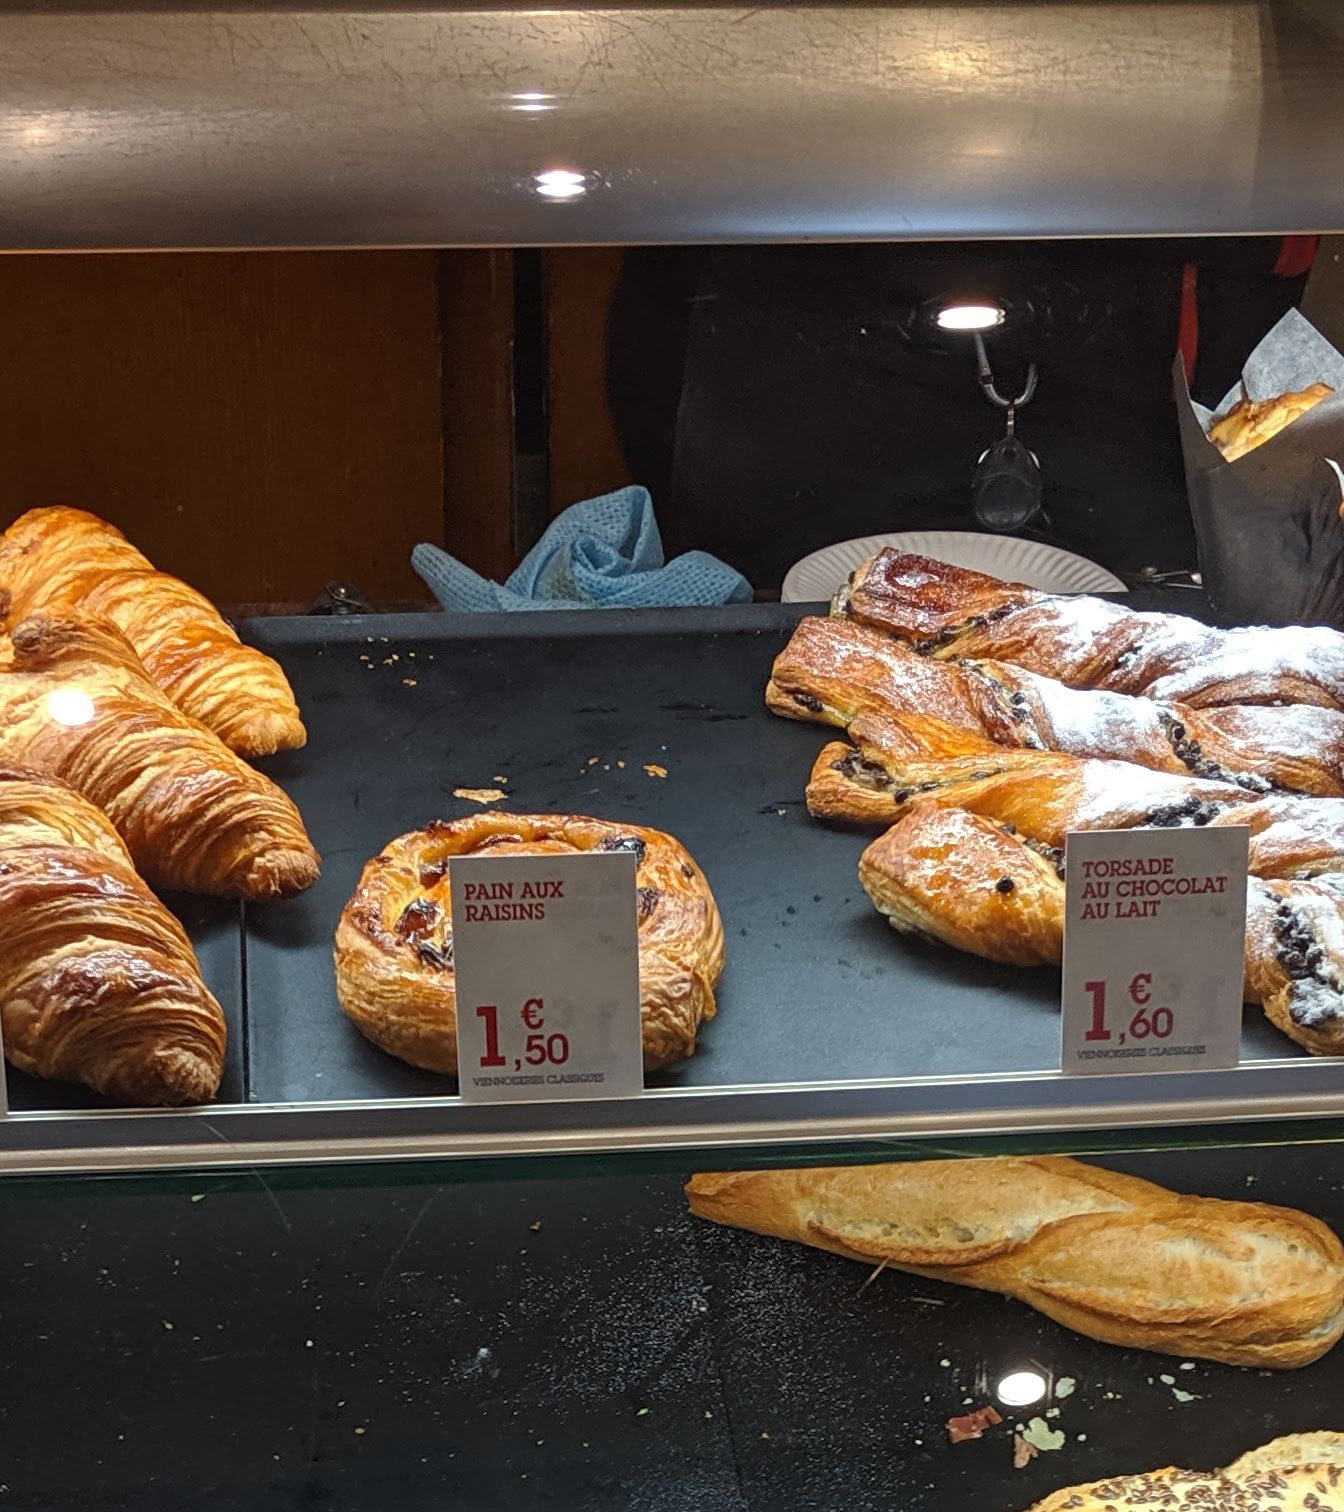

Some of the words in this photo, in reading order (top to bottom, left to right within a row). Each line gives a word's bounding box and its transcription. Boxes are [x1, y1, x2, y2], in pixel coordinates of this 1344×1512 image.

[1082, 858, 1174, 878] TORSADE
[464, 882, 513, 901] PAIN
[520, 881, 565, 899] AUX
[1081, 881, 1110, 899] AU
[1116, 876, 1228, 897] CHOCOLAT
[465, 903, 545, 922] RAISINS
[1080, 903, 1110, 920] AU
[1115, 900, 1161, 918] LAIT
